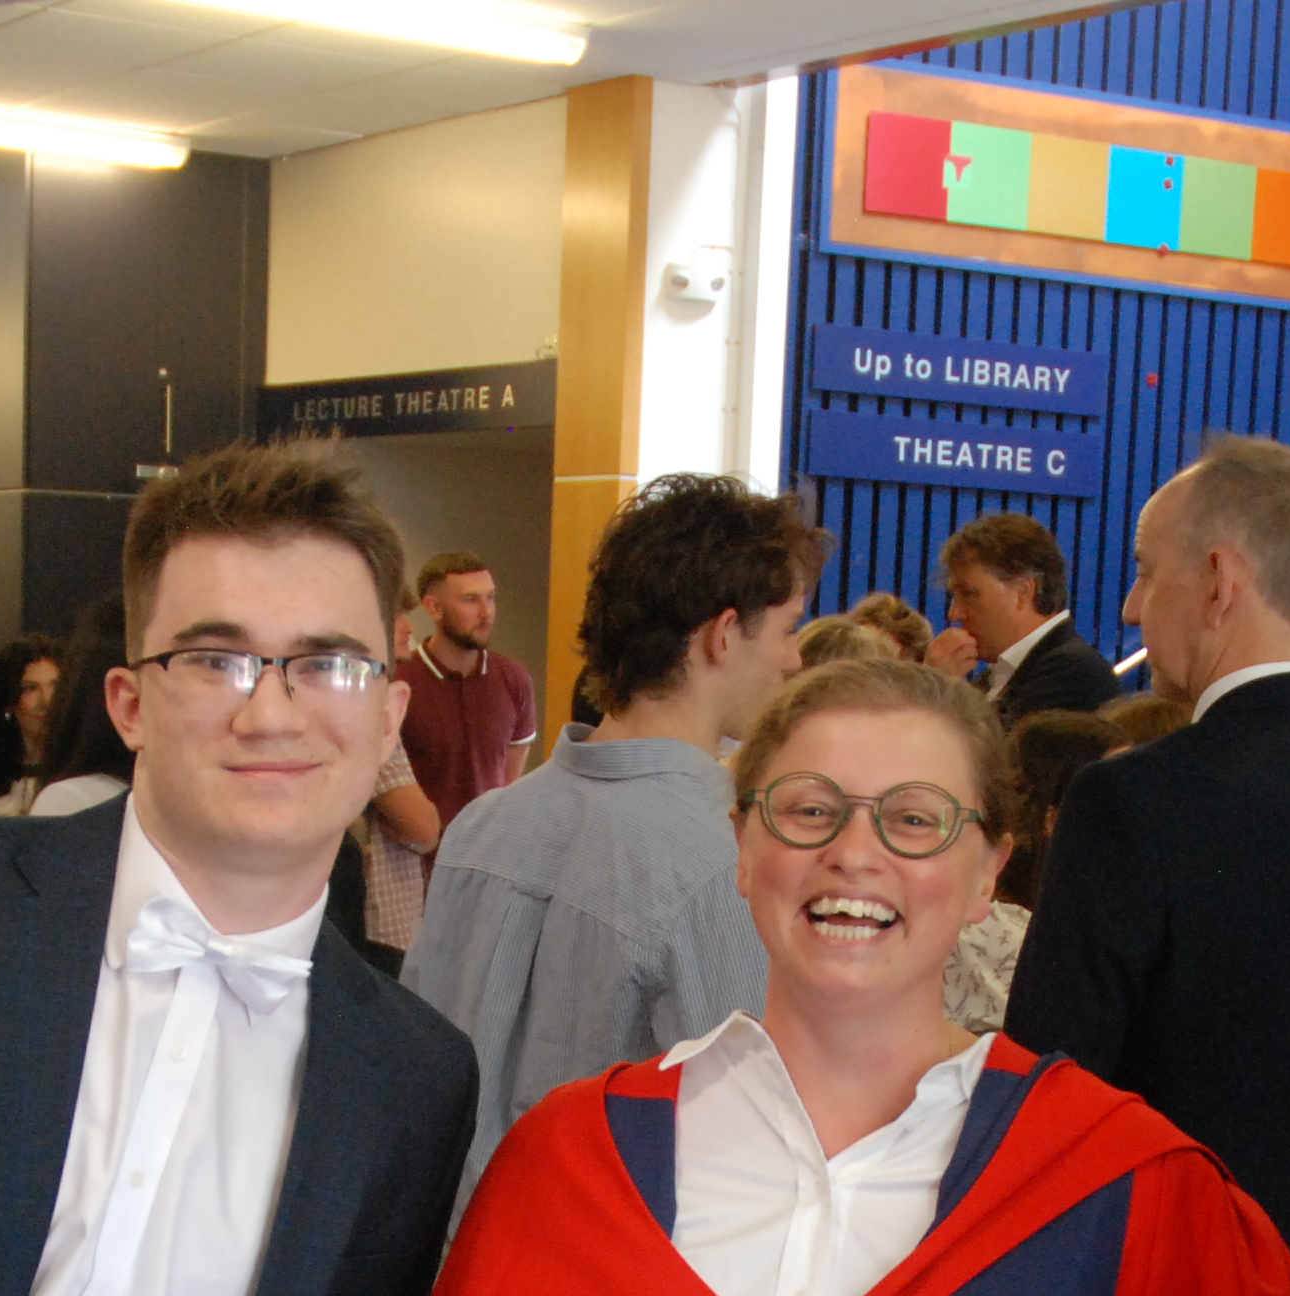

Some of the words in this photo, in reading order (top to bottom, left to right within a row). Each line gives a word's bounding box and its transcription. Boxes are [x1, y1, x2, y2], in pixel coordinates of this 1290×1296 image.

[854, 347, 892, 381] Up
[904, 353, 933, 380] to
[945, 356, 1071, 393] LIBRARY
[293, 393, 383, 422] LECTURE
[393, 384, 491, 416] THEATRE
[501, 383, 515, 408] A
[894, 435, 1032, 473] THEATRE
[1046, 449, 1066, 476] C
